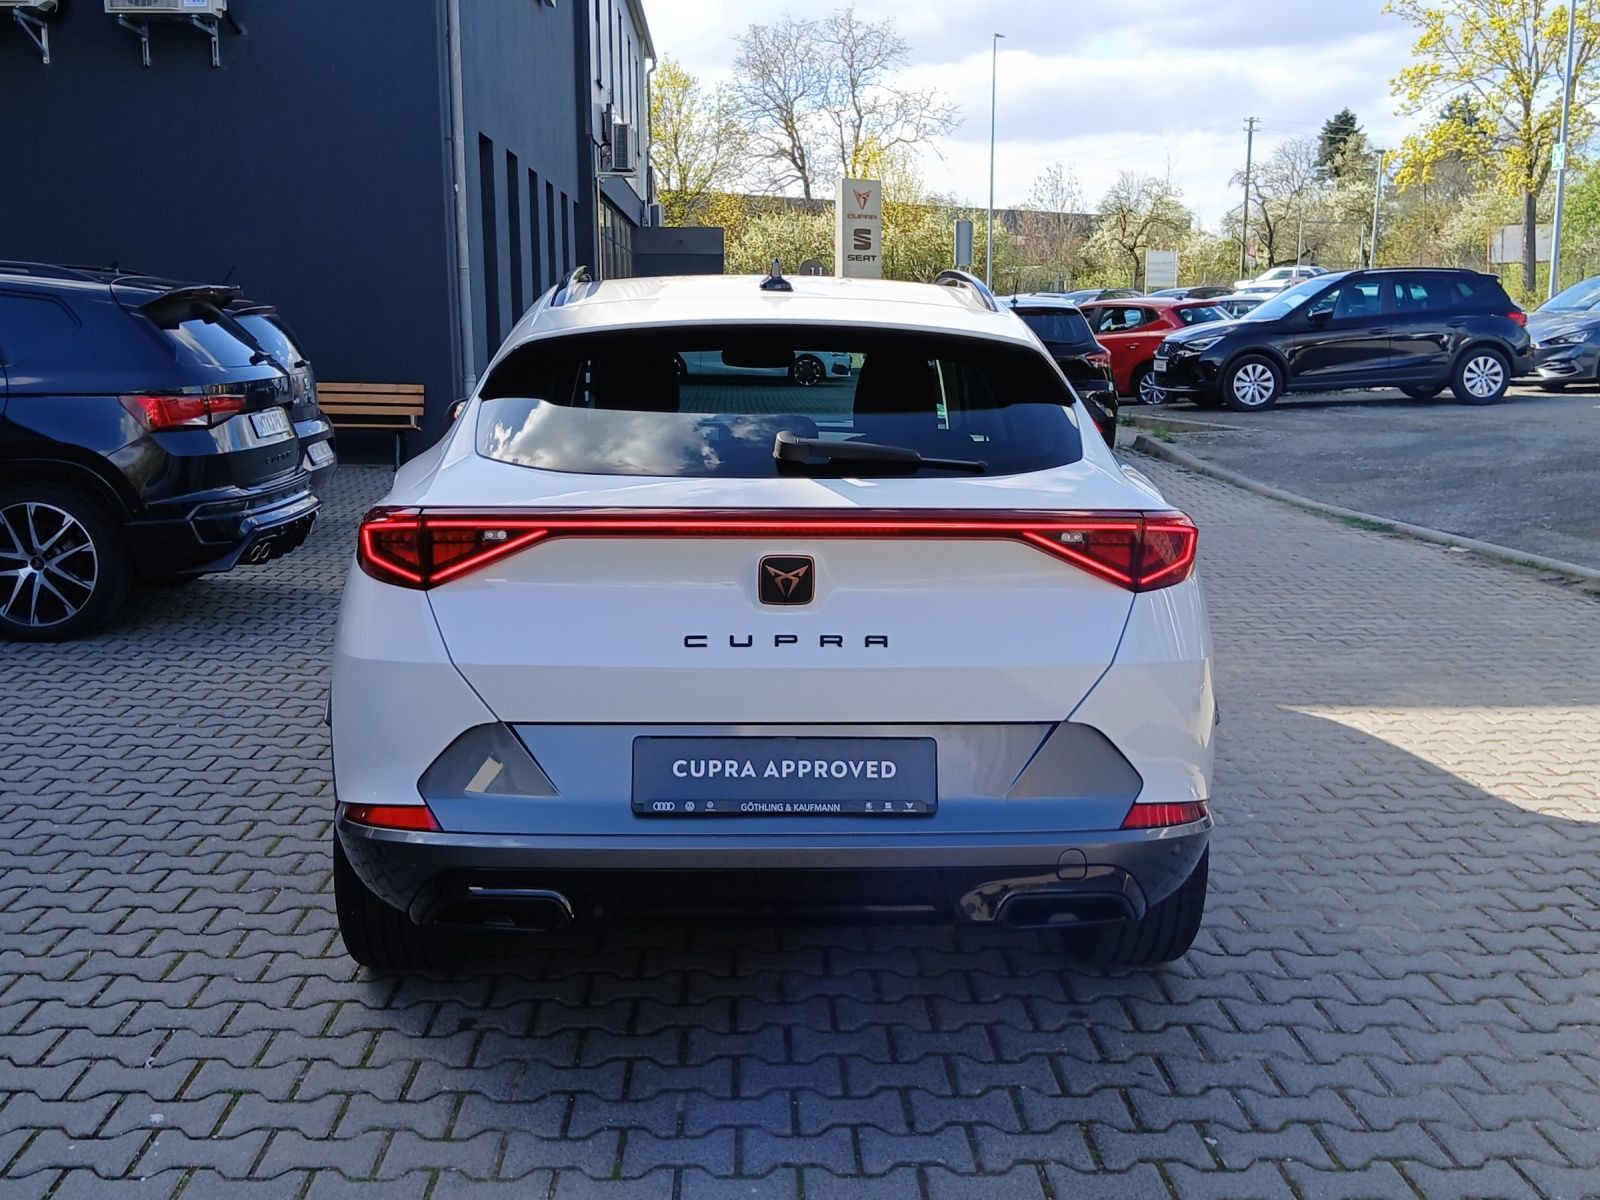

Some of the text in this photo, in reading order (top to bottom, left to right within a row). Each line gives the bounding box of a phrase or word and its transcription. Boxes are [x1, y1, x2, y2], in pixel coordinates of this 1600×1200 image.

[847, 254, 877, 262] SEAT
[683, 634, 889, 648] CUPRA
[672, 759, 897, 779] CUPRA APPROVED
[740, 801, 841, 812] GÖTHLING & KAUFMANN
